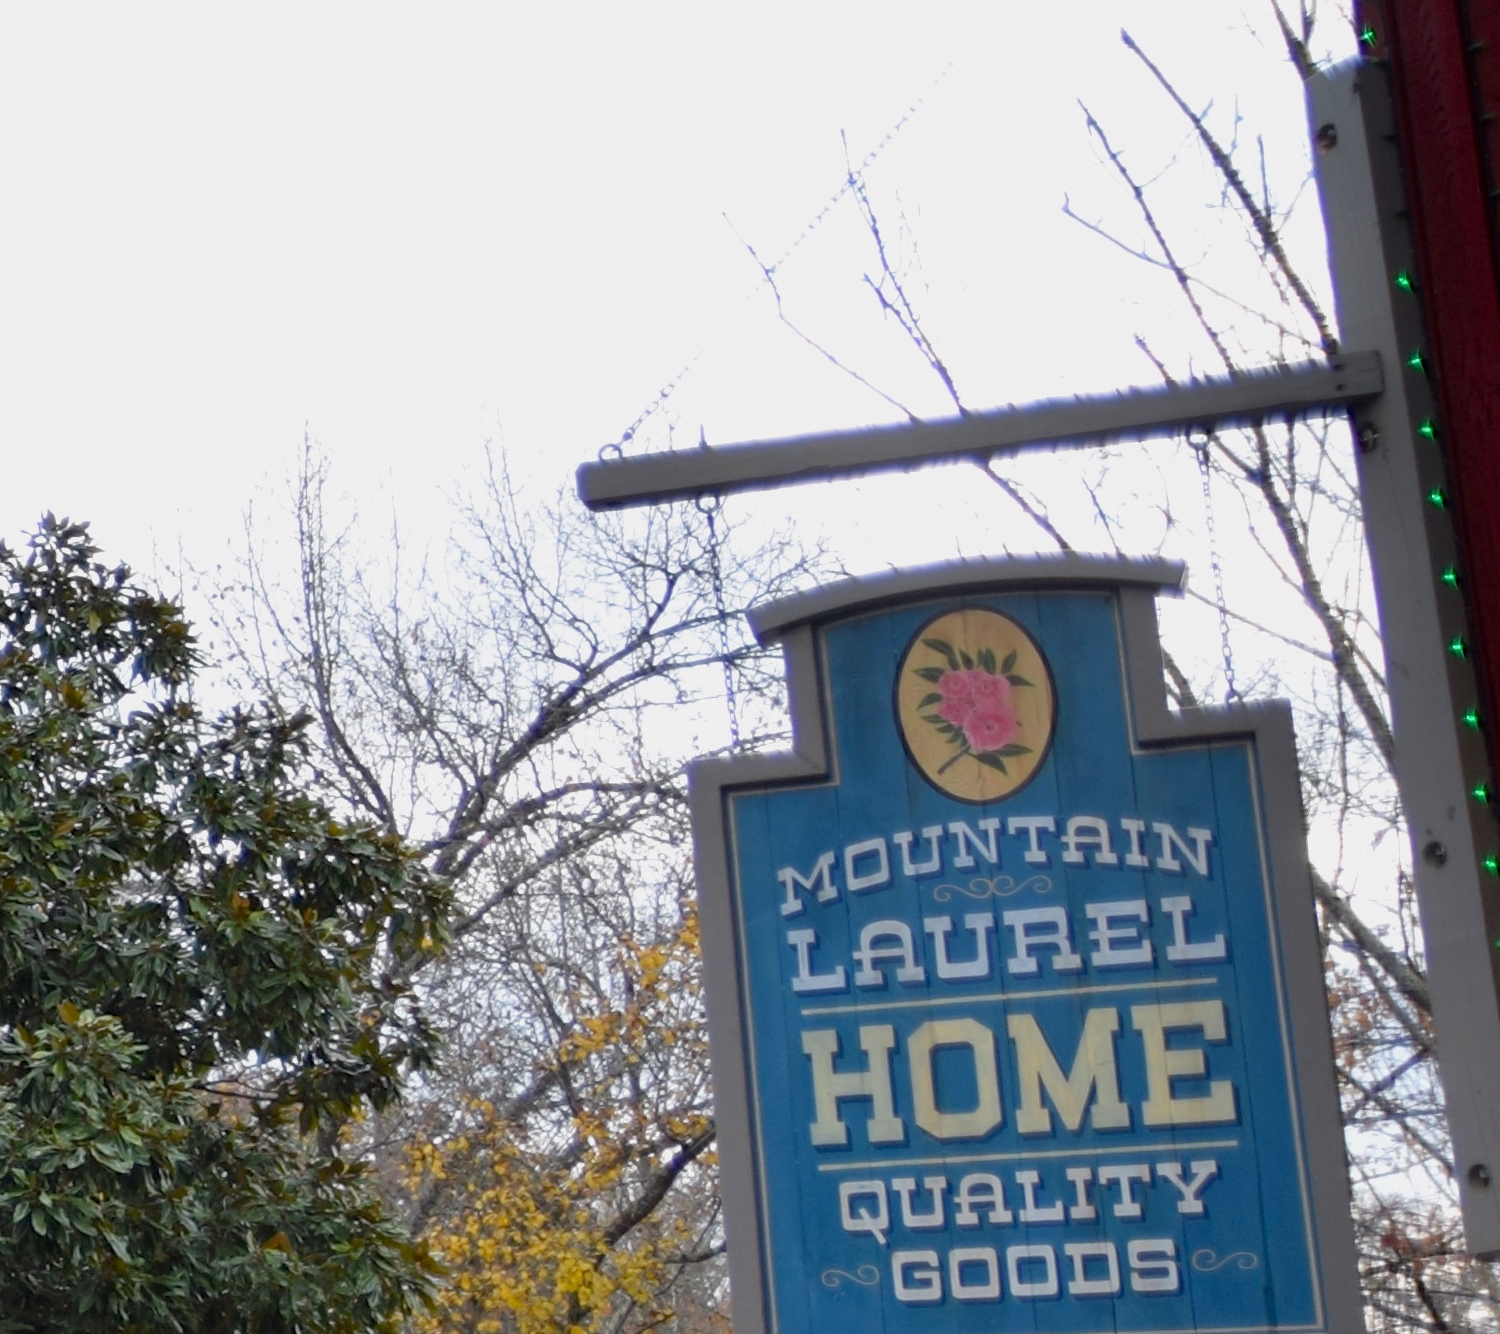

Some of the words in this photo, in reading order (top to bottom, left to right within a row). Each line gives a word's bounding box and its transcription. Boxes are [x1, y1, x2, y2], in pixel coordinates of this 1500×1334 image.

[777, 815, 1213, 917] MOUNTAIN
[786, 895, 1227, 995] LAUREL
[801, 999, 1239, 1149] HOME
[838, 1159, 1218, 1245] QUALITY
[891, 1238, 1182, 1304] GOODS
